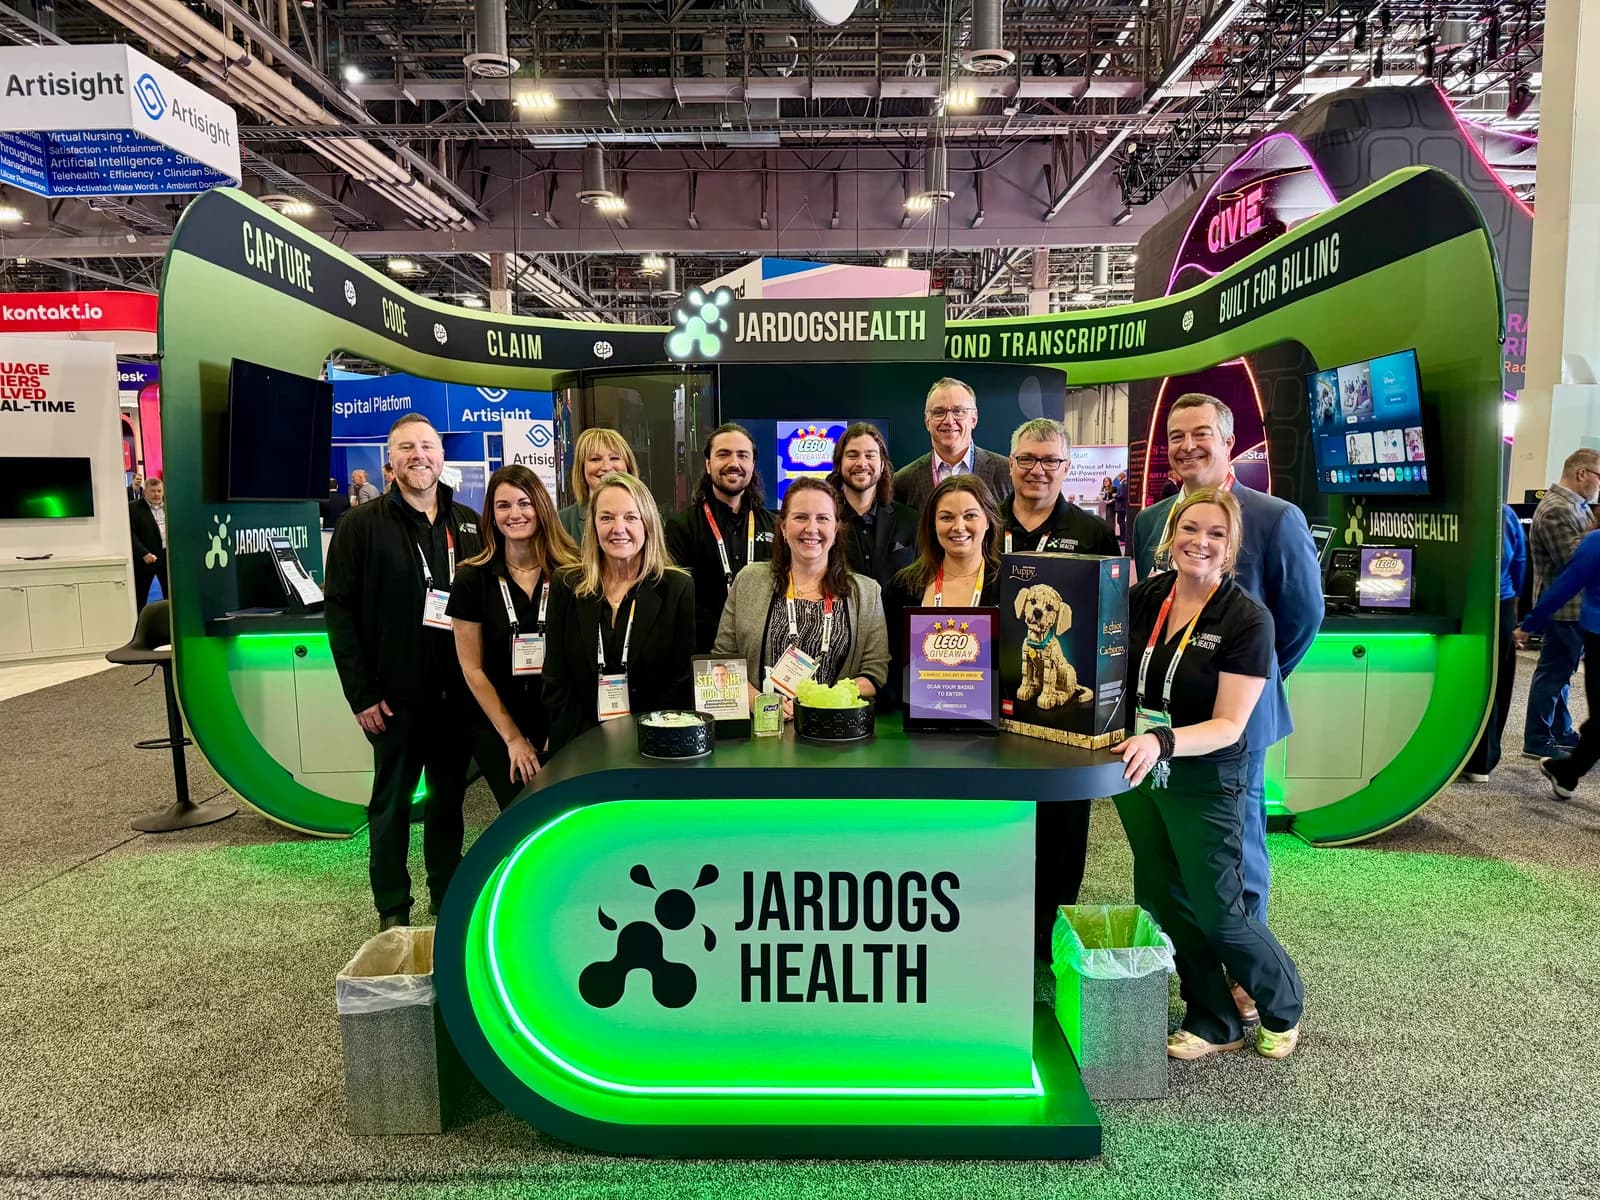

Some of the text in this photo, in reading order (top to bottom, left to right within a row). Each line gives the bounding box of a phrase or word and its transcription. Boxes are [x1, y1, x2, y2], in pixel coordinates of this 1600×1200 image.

[5, 72, 125, 101] Artisight
[172, 98, 230, 147] Artisight
[47, 132, 81, 142] Virtual
[83, 131, 122, 143] Nursing
[49, 143, 165, 155] Satisfaction Infotainment
[50, 157, 97, 168] Artificial
[99, 155, 163, 169] Intelligence
[52, 171, 100, 181] Telehealth
[109, 168, 154, 180] Efficiency
[163, 167, 203, 178] Clinician
[52, 184, 112, 193] Voice-Activated
[113, 183, 134, 192] Wake
[134, 182, 159, 191] Words
[166, 181, 198, 191] Ambient
[243, 221, 314, 294] CAPTURE
[1219, 232, 1340, 324] BUILT FOR BILLING
[2, 303, 103, 321] kontakt.io
[382, 297, 409, 338] CODE
[735, 310, 926, 343] JARDOGSHEALTH
[487, 330, 542, 361] CLAIM
[1000, 320, 1147, 358] TRANSCRIPTION
[0, 375, 41, 388] IERS
[0, 388, 47, 400] LVED
[0, 400, 76, 413] AL-TIME
[373, 394, 412, 413] Platform
[461, 402, 532, 422] Artisight
[798, 439, 828, 453] LEGO
[1369, 511, 1458, 543] JARDOGSHEALTH
[1376, 559, 1398, 569] LEGO
[933, 634, 969, 650] LEGO
[929, 649, 973, 659] GIVEAWAY
[735, 870, 960, 933] JARDOGS
[741, 943, 928, 1004] HEALTH
